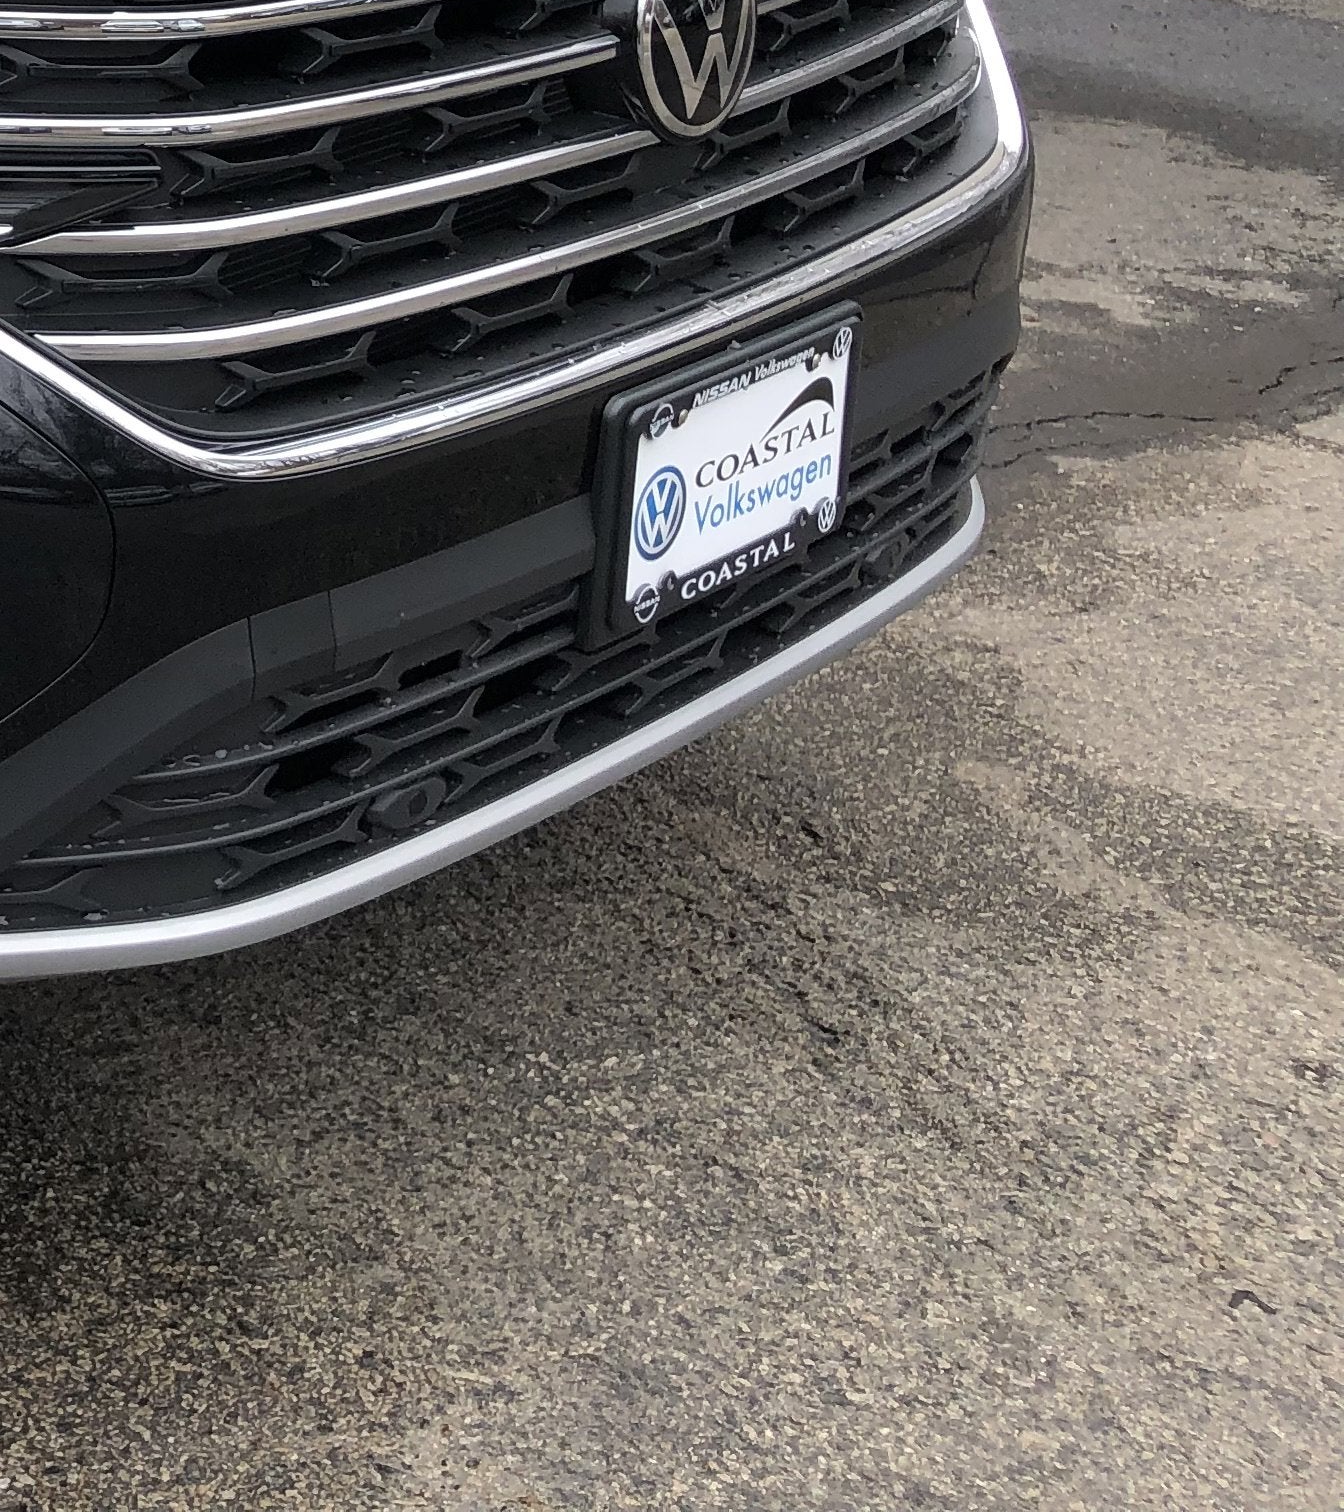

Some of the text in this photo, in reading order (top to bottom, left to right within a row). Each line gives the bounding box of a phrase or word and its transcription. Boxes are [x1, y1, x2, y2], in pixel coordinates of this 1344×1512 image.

[692, 346, 816, 409] NISSAN Volkswagen
[694, 412, 836, 489] COASTAL
[694, 453, 832, 535] Volkswagen
[680, 531, 797, 601] COASTAL
